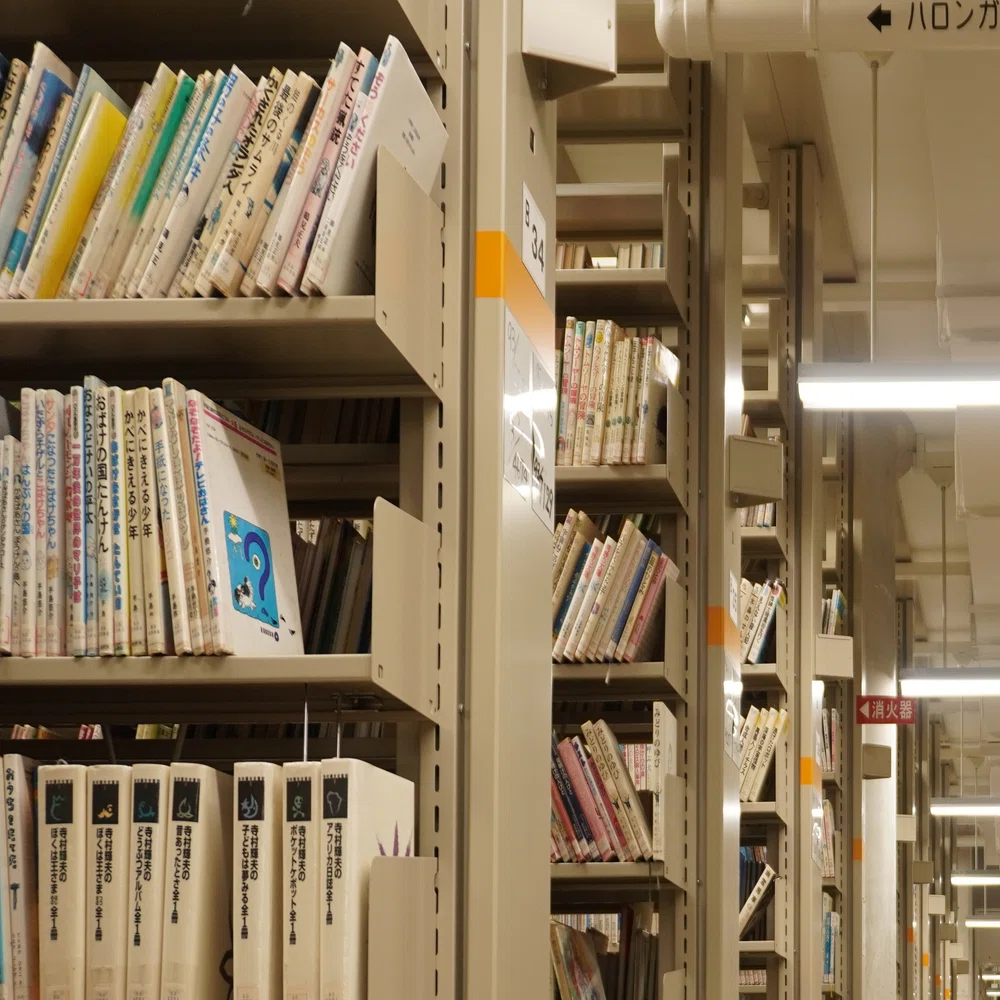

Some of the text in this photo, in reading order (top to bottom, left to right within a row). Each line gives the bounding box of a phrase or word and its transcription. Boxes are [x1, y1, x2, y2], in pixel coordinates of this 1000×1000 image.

[240, 84, 292, 194] 最後のサムライ
[531, 226, 545, 273] 34
[96, 395, 109, 553] おばけの国たんけん
[124, 410, 139, 540] かべにきえる少年
[137, 409, 153, 539] かべにきえる少年
[872, 700, 913, 719] 消火器
[58, 827, 68, 883] 寺村輝夫の
[104, 827, 113, 883] 寺村輝夫の
[143, 826, 153, 882] 寺村輝夫の
[181, 825, 192, 881] 寺村輝夫の
[250, 825, 259, 880] 寺村輝夫の
[298, 825, 306, 881] 寺村輝夫の
[334, 822, 343, 879] 寺村輝夫の
